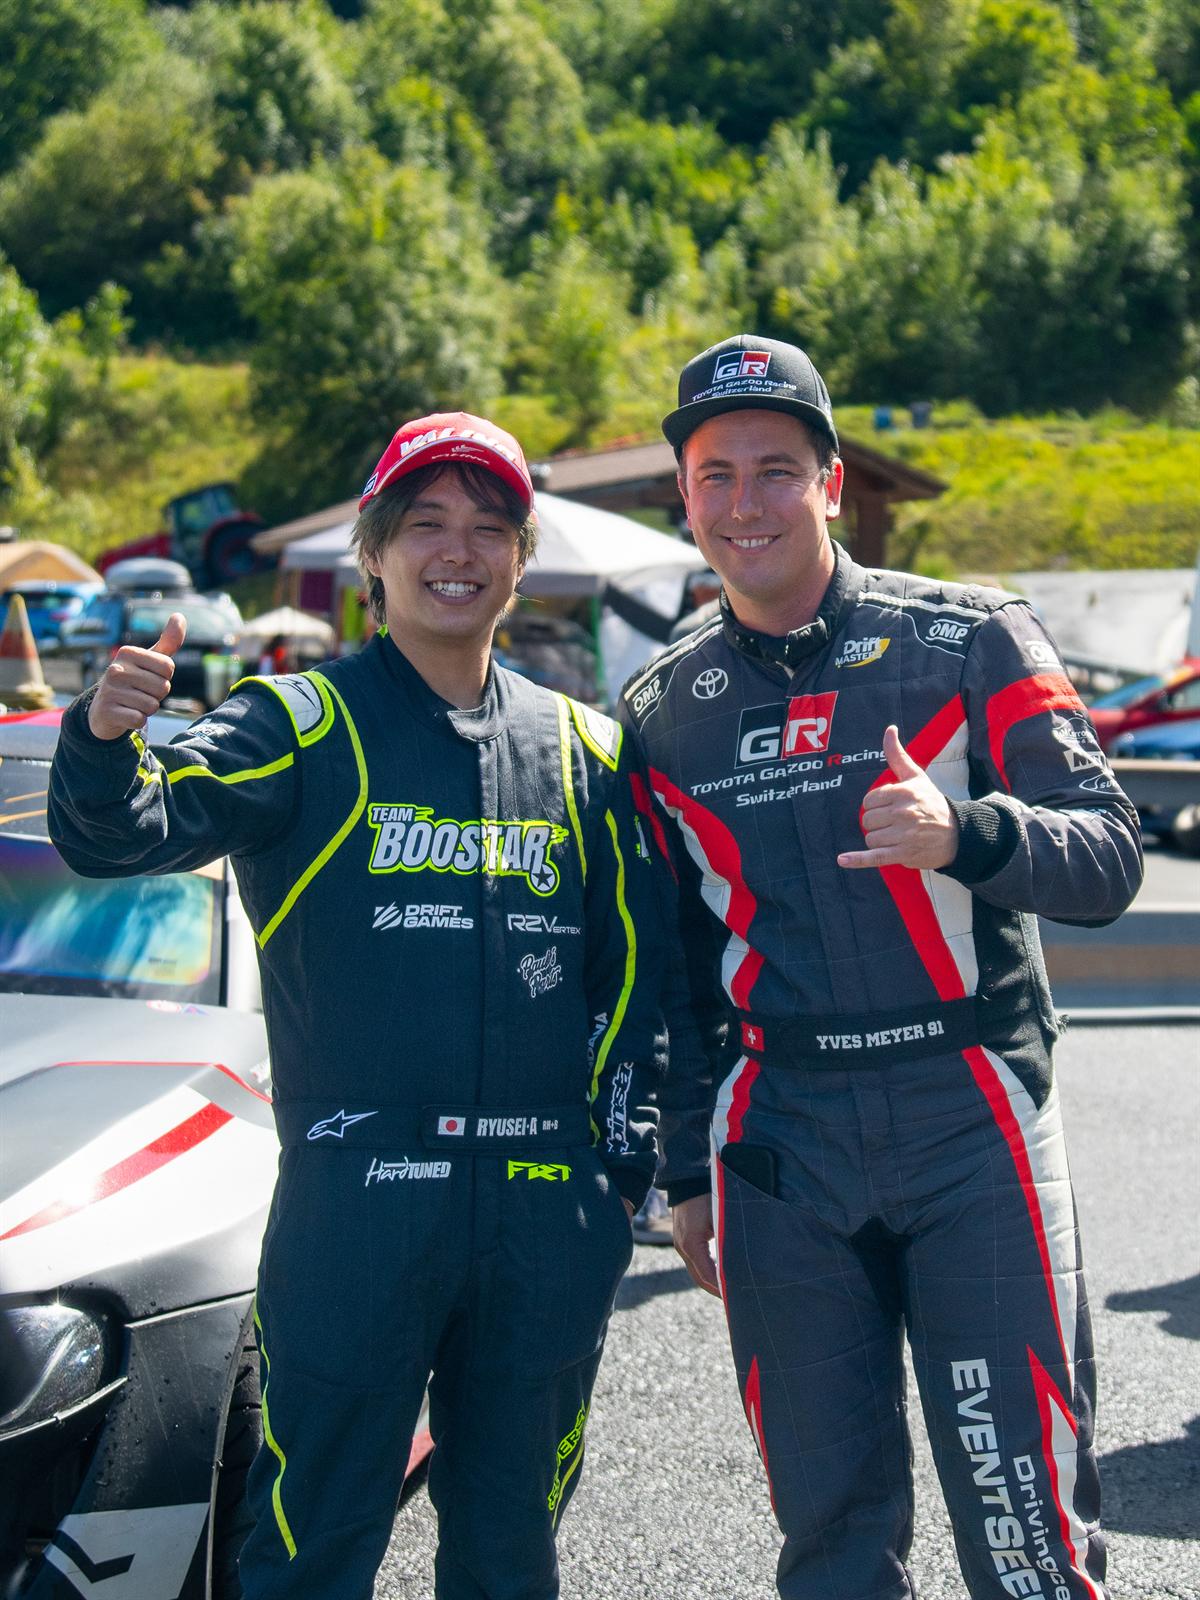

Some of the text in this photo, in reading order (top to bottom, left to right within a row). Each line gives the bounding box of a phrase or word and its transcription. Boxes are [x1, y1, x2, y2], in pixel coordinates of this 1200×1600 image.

[716, 361, 766, 379] GR
[691, 379, 797, 401] TOYOTA GAZOO Racing
[712, 385, 772, 397] Switzerland
[929, 621, 968, 640] OMP
[843, 637, 882, 655] Drift
[633, 678, 661, 712] OMP
[740, 717, 828, 762] GR
[690, 750, 887, 796] TOYOTA GAZOO Racing
[736, 775, 843, 807] Switzerland
[372, 807, 413, 822] TEAM
[371, 822, 551, 873] BOOSTAR
[404, 904, 463, 917] DRIFT
[403, 917, 473, 929] GAMES
[816, 1020, 944, 1050] YVES MEYER 91
[951, 1358, 1046, 1600] EVENTSEE
